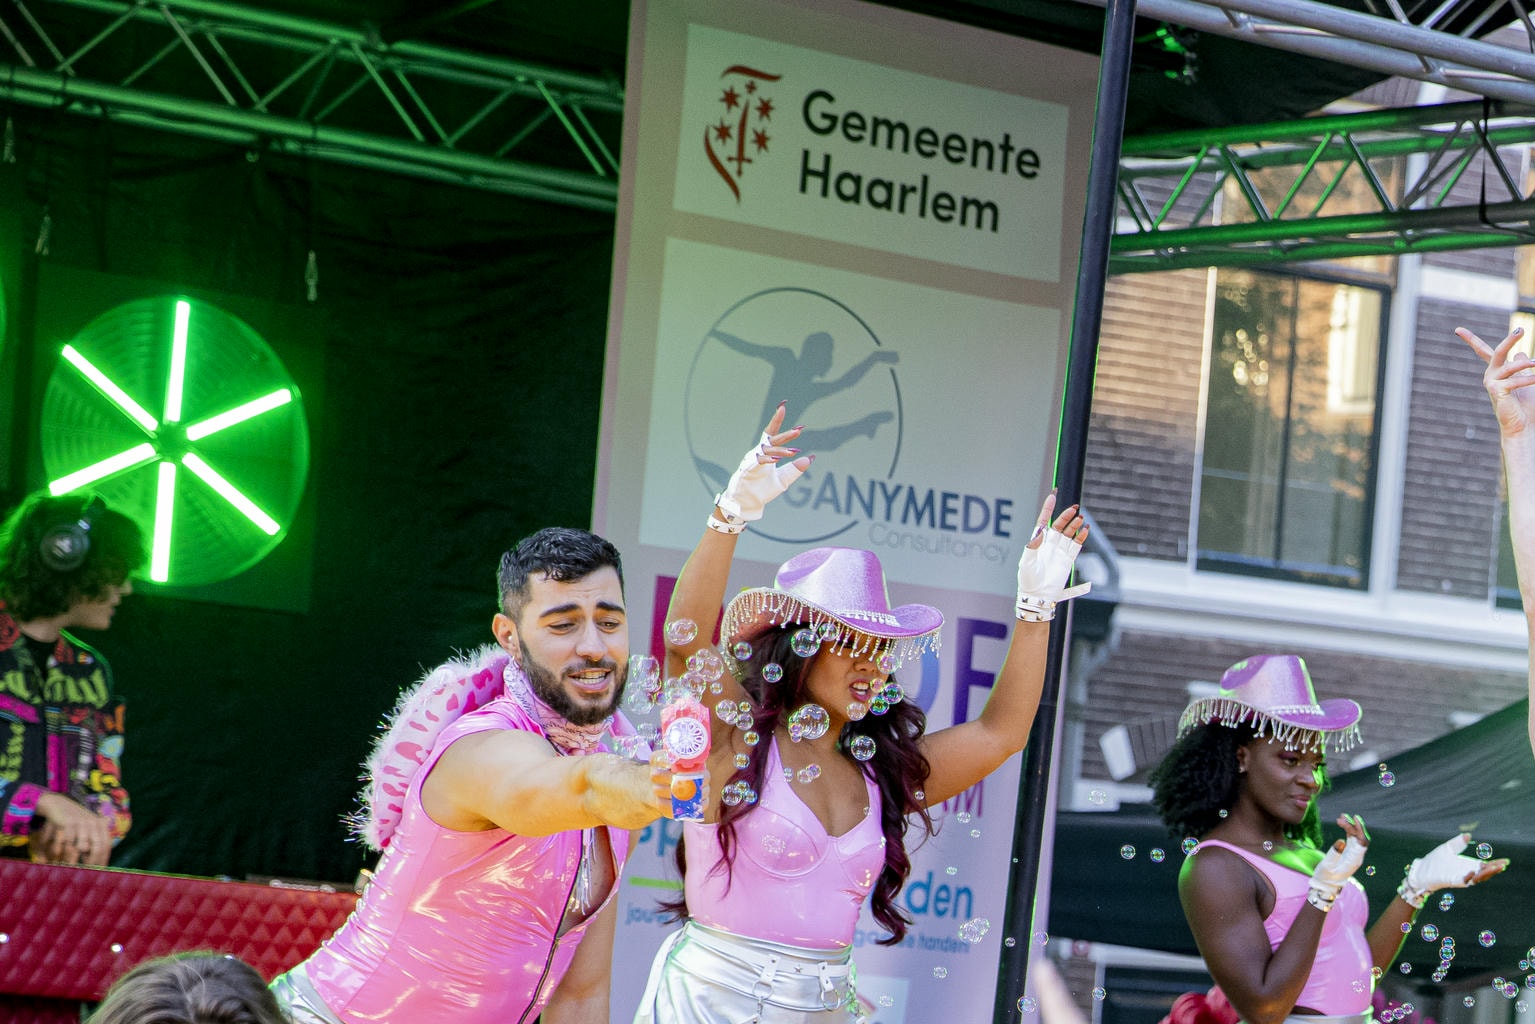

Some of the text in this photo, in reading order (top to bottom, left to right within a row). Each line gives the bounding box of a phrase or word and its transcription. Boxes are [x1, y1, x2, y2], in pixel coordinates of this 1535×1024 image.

[802, 90, 1041, 180] Gemeente
[799, 149, 999, 233] Haarlem
[785, 471, 1013, 538] GANYMEDE
[868, 522, 1010, 564] Consultancy
